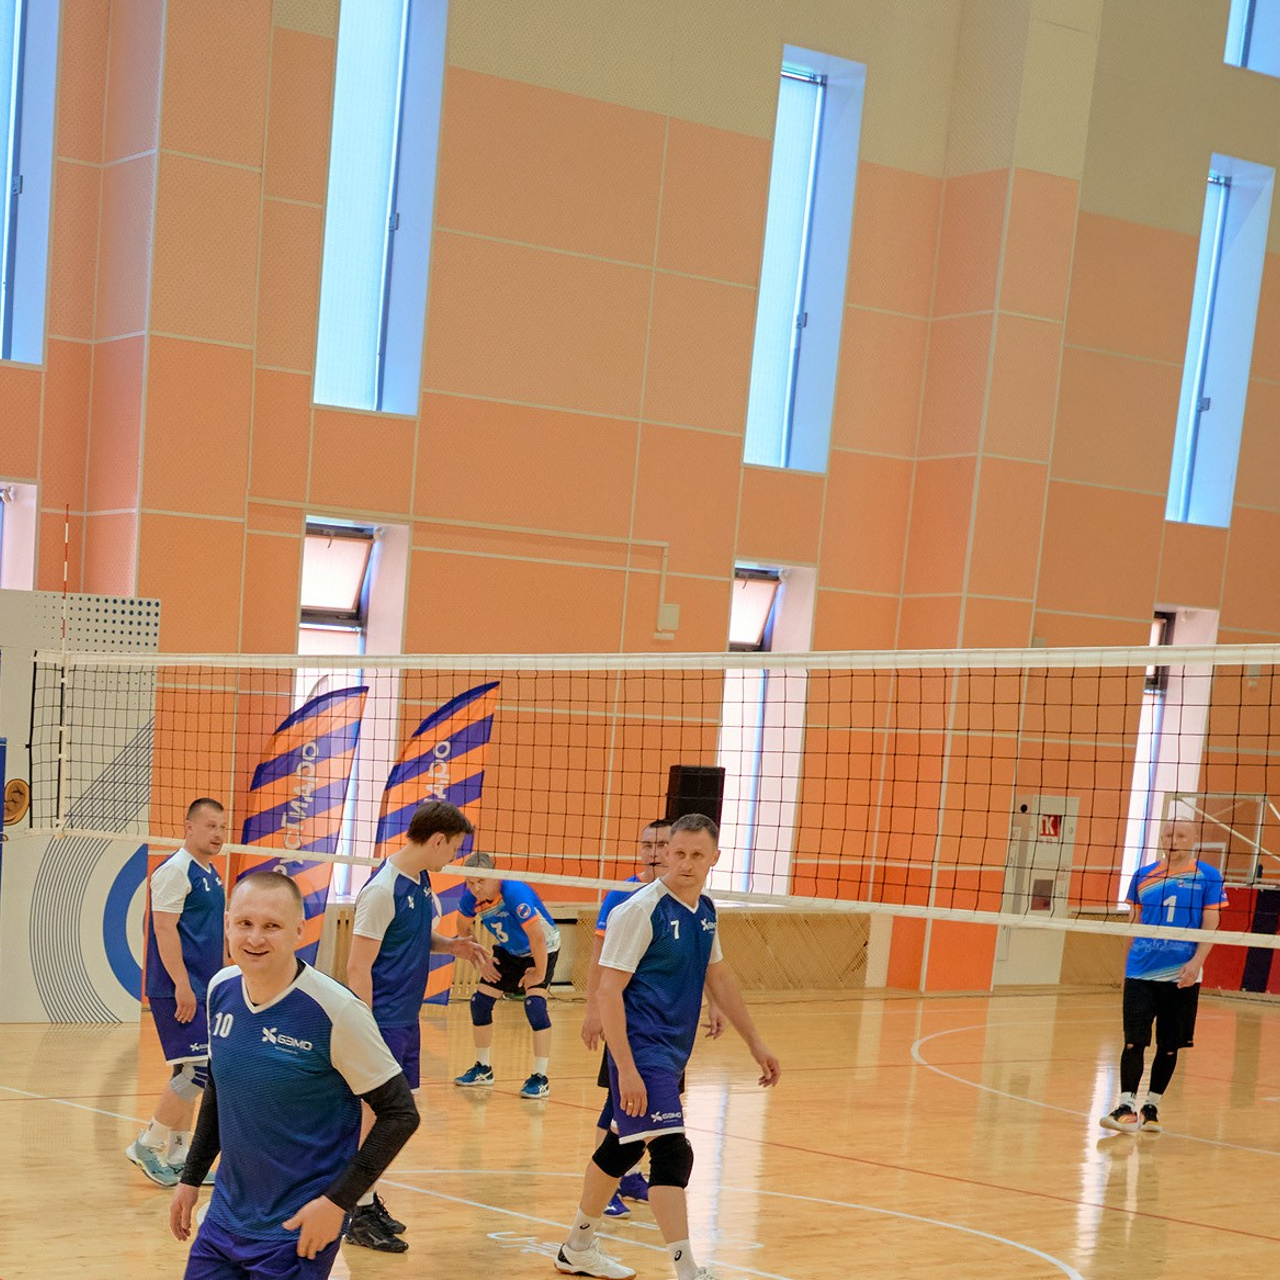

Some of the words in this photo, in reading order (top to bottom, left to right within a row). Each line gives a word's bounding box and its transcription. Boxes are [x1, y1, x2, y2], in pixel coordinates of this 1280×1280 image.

[1163, 895, 1177, 922] 1
[490, 922, 509, 943] 3
[670, 920, 680, 939] 7
[213, 1012, 234, 1038] 10
